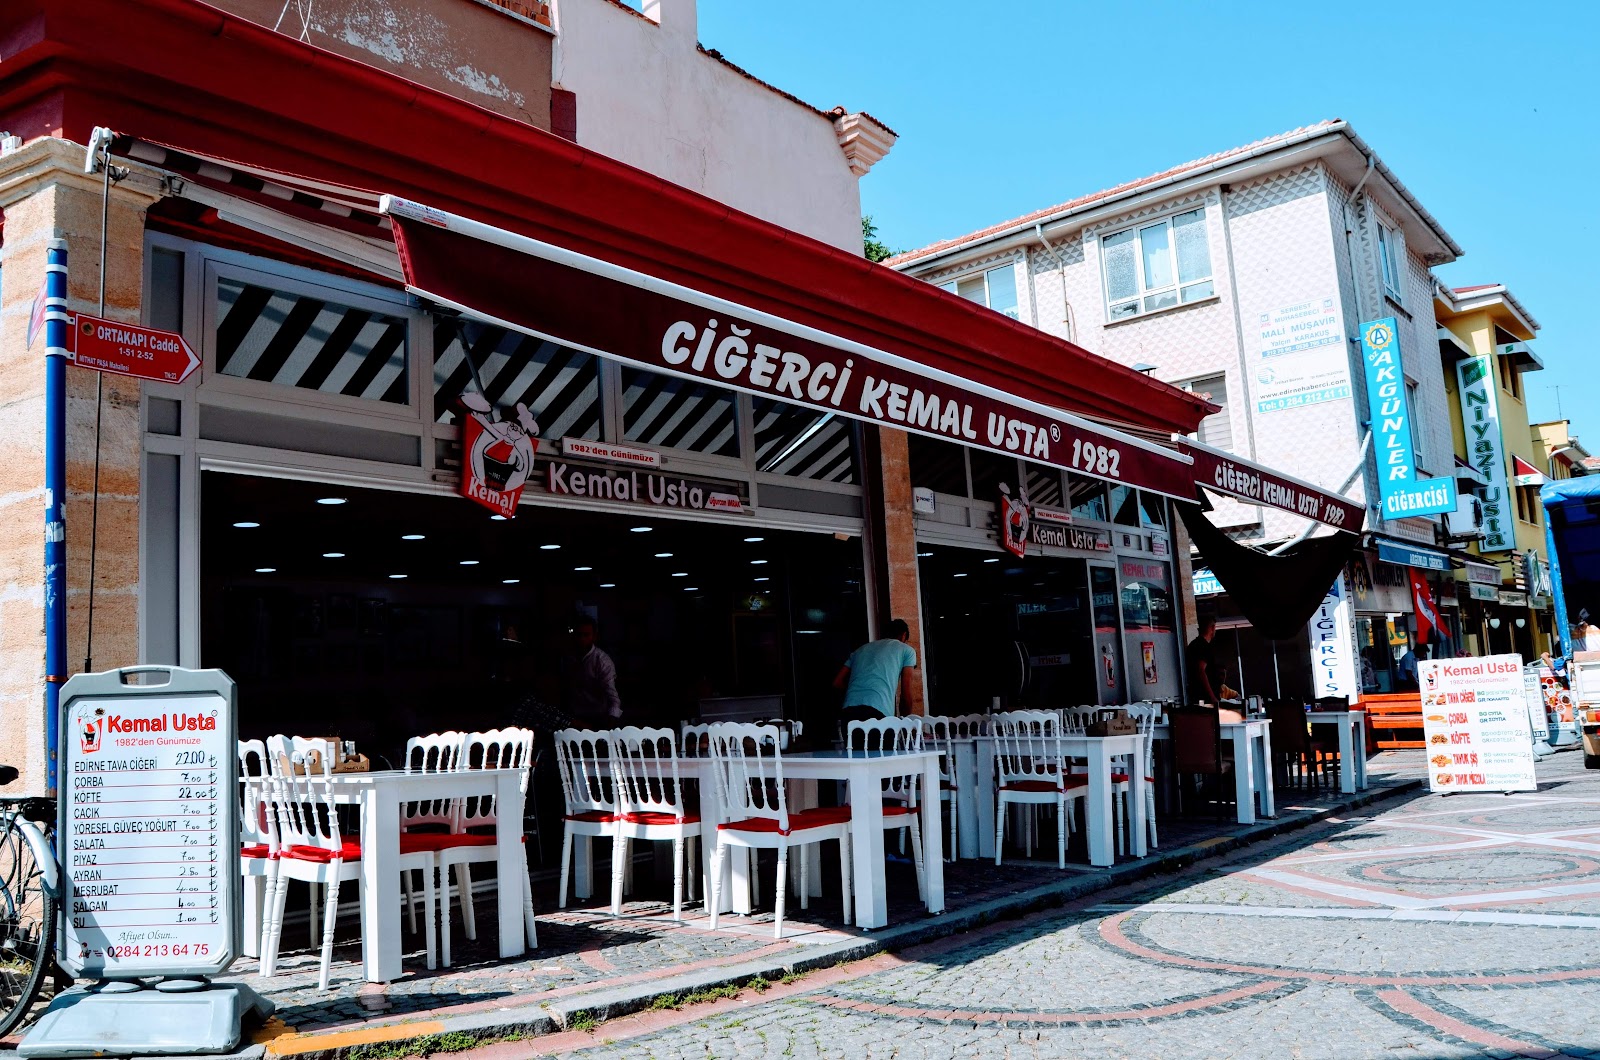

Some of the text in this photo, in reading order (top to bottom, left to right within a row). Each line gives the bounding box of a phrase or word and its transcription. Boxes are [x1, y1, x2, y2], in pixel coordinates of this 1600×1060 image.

[1280, 303, 1311, 314] SERBEST
[1262, 316, 1336, 339] MALİ MÜŞAVİR
[98, 326, 180, 353] ORTAKAPI Cadde
[119, 347, 154, 360] 1-51 2-52
[1260, 378, 1346, 399] www.edirnehaberci.com
[661, 318, 854, 406] CİĞERCİ
[860, 376, 977, 440] KEMAL
[1072, 438, 1120, 478] 1982
[1261, 387, 1348, 411] Tel: 0 284 212 41 11
[1373, 350, 1408, 481] AKGÜNLER
[570, 444, 654, 463] 1982'den Günümüze
[468, 476, 516, 510] Kemal
[550, 462, 704, 510] Kemal Usta
[1214, 462, 1262, 498] CİĞERCİ
[1263, 481, 1296, 510] KEMAL
[1324, 504, 1346, 525] 1982
[1388, 484, 1449, 512] CİĞERCİSİ
[1479, 486, 1506, 548] Usta
[1033, 524, 1093, 550] Kemal Usta
[1444, 662, 1517, 676] Kemal Usta
[108, 714, 166, 733] Kemal
[1449, 712, 1468, 726] ÇORBA
[114, 736, 201, 747] 1982'den Günümüze
[1451, 731, 1470, 744] KÖFTE
[75, 756, 158, 772] EDİRNE TAVA CİĞERİ
[75, 776, 104, 790] ÇORBA
[181, 772, 201, 782] 7.00
[178, 787, 207, 798] 22.00
[74, 808, 100, 818] CACIK
[74, 818, 177, 834] YÖRESEL GÜVEÇ YOĞURT
[74, 839, 104, 849] SALATA
[74, 852, 97, 865] PİYAZ
[74, 870, 102, 881] AYRAN
[74, 885, 118, 898] MEŞRUBAT
[74, 917, 85, 928] SU
[118, 931, 145, 944] Afiyet
[107, 945, 140, 957] 0284
[144, 945, 168, 956] 213
[172, 944, 188, 956] 64
[193, 944, 208, 955] 75
